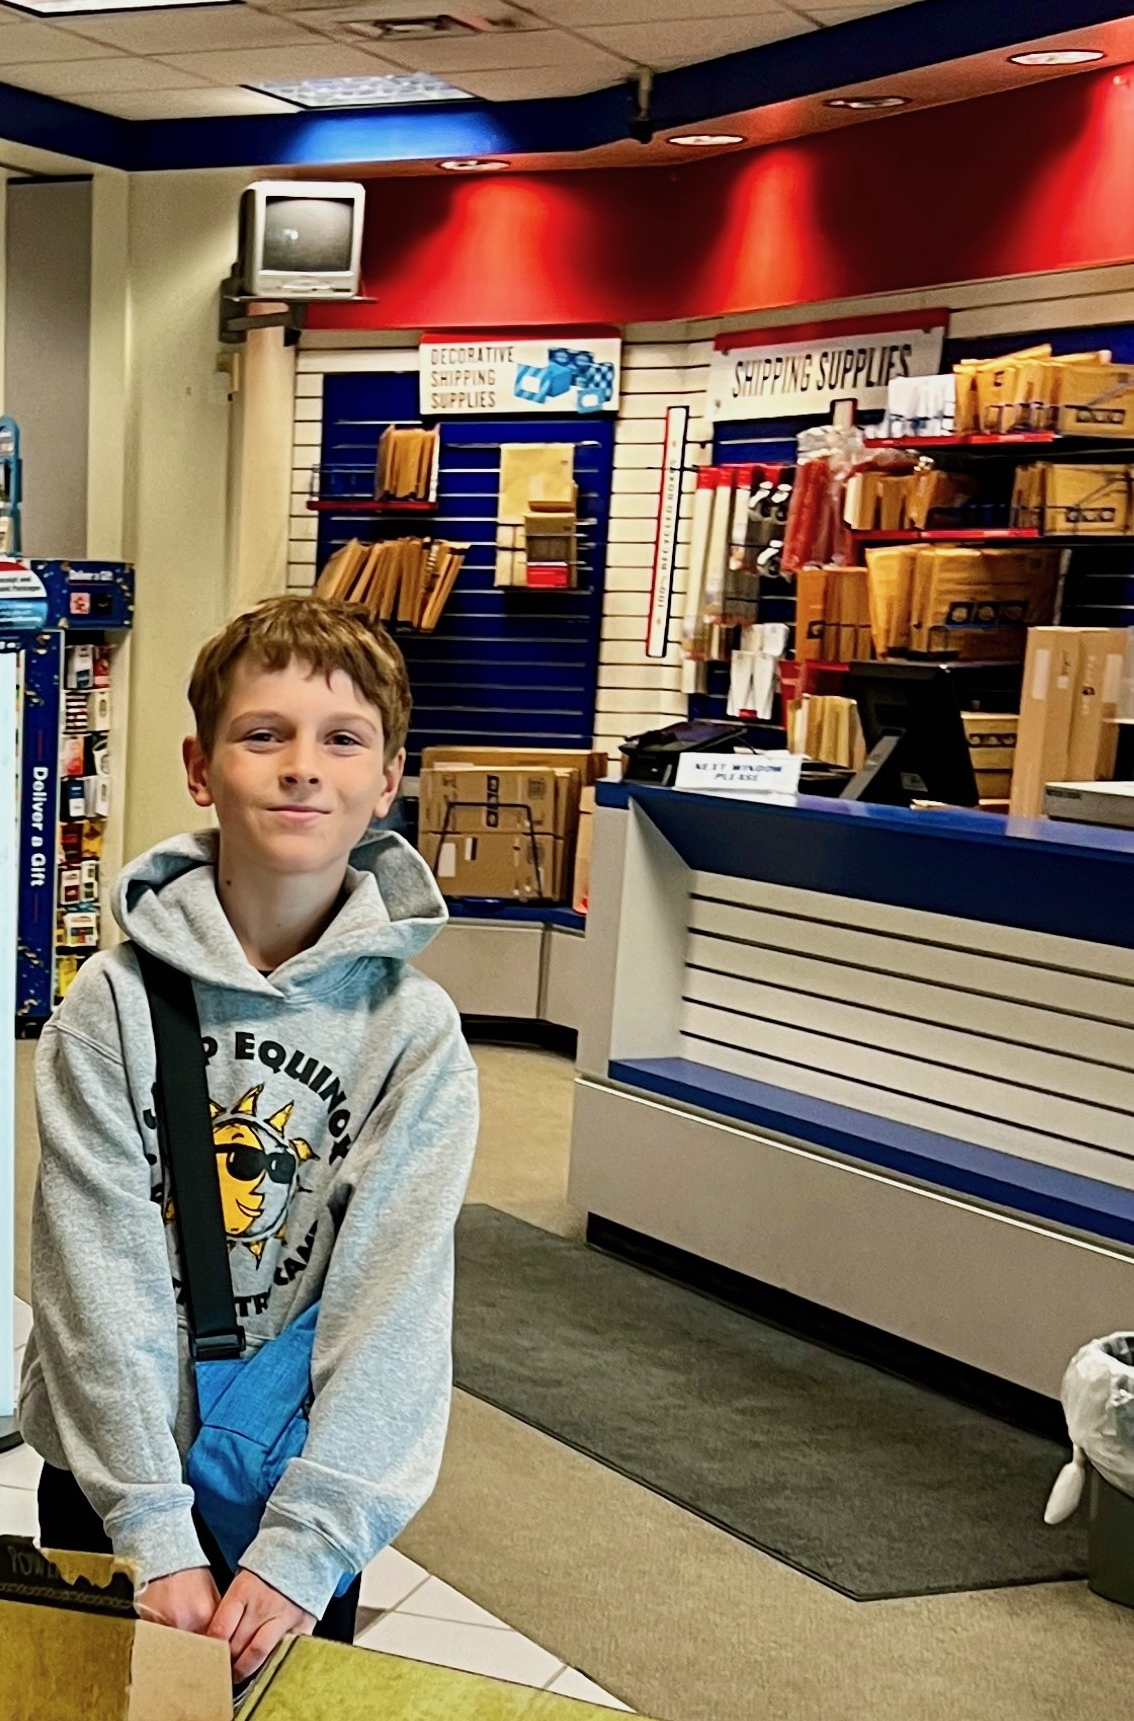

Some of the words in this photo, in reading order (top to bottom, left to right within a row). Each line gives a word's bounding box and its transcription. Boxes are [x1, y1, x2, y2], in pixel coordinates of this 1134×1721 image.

[431, 346, 514, 366] DECORATIVE
[431, 369, 496, 387] SHIPPING
[732, 353, 812, 398] SHIPPING
[816, 344, 913, 392] SUPPLIES
[431, 391, 496, 409] SUPPLIES
[31, 767, 49, 831] Deliver
[31, 836, 43, 847] a
[30, 853, 46, 887] Gift
[235, 1031, 351, 1166] EQUINOX
